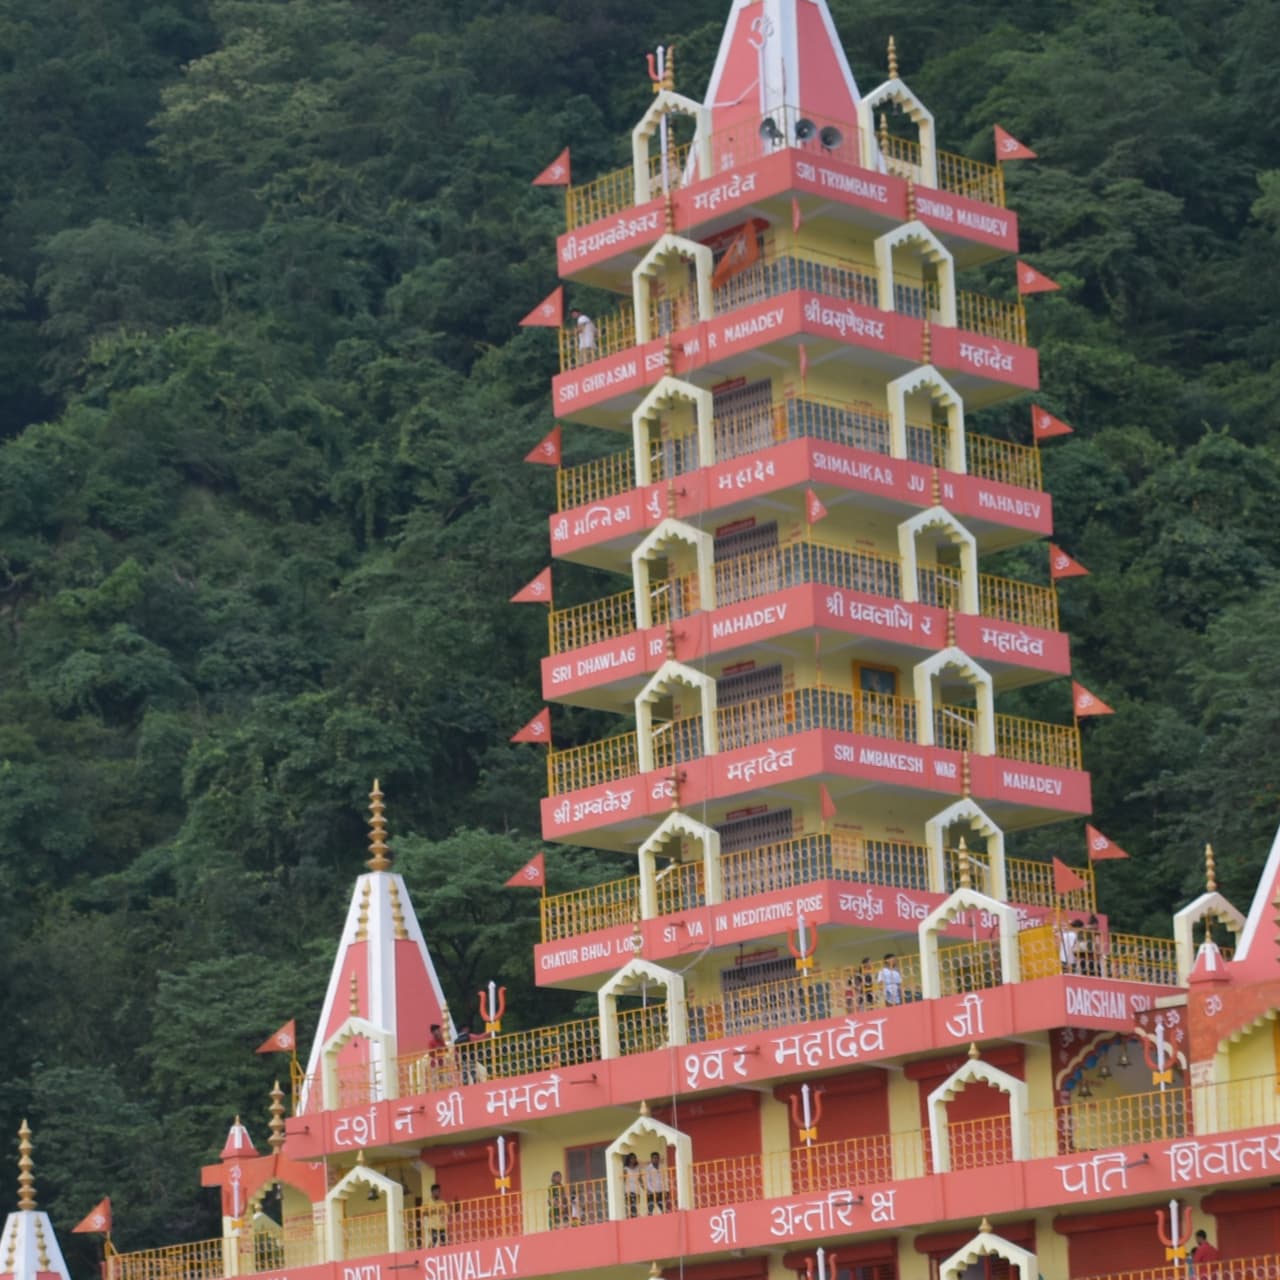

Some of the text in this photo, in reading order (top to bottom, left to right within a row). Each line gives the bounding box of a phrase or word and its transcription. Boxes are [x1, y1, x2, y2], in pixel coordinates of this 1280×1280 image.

[693, 172, 757, 209] महादेव
[796, 161, 816, 181] SRI
[956, 209, 1008, 237] MAHADEV
[559, 383, 579, 403] SRI
[724, 308, 784, 344] MAHADEV
[959, 342, 1014, 372] महादेव
[554, 519, 569, 542] श्री
[719, 460, 777, 489] महादेव
[978, 491, 1041, 520] MAHADEV
[552, 664, 571, 684] SRI
[712, 603, 787, 639] MAHADEV
[826, 592, 844, 617] श्री
[982, 627, 1044, 656] महादेव
[553, 800, 571, 825] श्री
[727, 748, 796, 781] महादेव
[834, 744, 854, 762] SRI
[859, 748, 923, 773] AMBAKESH
[1003, 771, 1062, 795] MAHADEV
[541, 946, 578, 969] CHATUR
[581, 942, 611, 962] BHUJ
[716, 916, 728, 931] IN
[733, 903, 794, 928] MEDITATIVE
[796, 893, 822, 914] POSE
[1065, 987, 1127, 1020] DARSHAN
[435, 1091, 465, 1127] श्री
[771, 1017, 888, 1067] महादेव
[946, 994, 984, 1038] जी
[710, 1208, 737, 1244] श्री
[1054, 1152, 1128, 1195] पति
